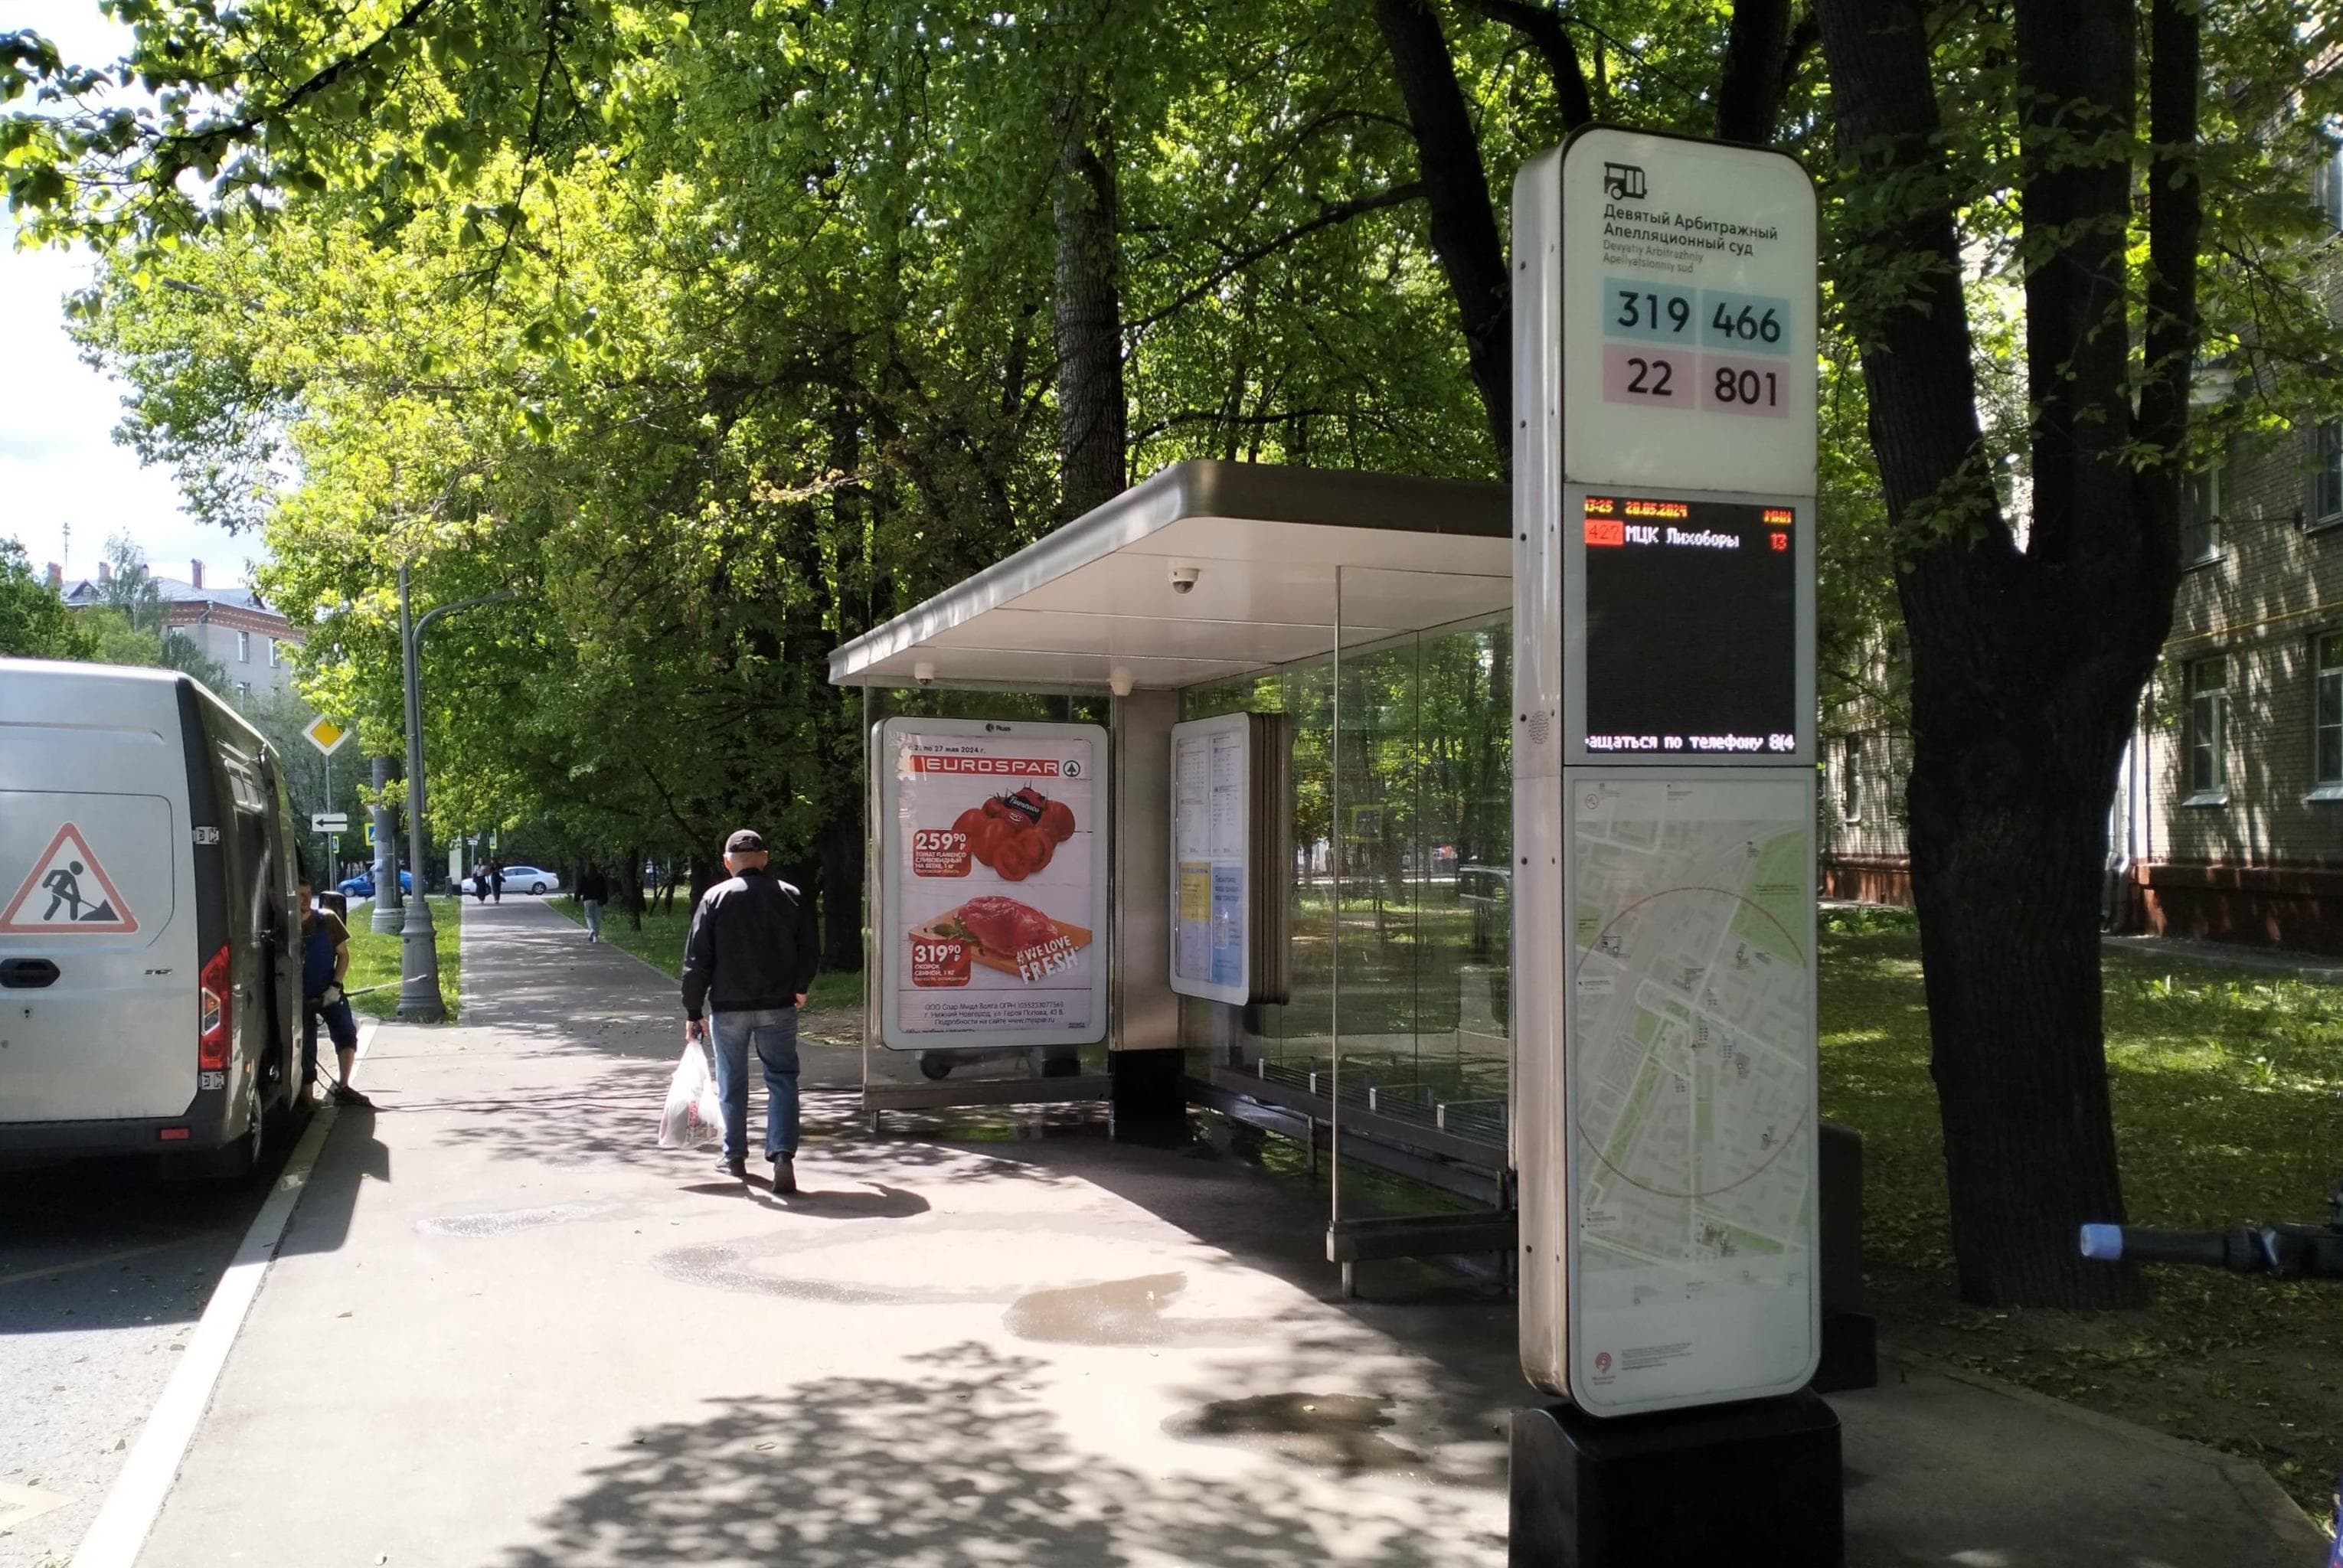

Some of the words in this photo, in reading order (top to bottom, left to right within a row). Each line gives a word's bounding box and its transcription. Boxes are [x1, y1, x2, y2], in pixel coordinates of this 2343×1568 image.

[1604, 204, 1670, 225] Девятый
[1675, 214, 1777, 240] Арбитражный
[1604, 222, 1725, 250] Апелляционный
[1729, 241, 1753, 256] суд
[1617, 289, 1690, 332] 319
[1712, 302, 1781, 344] 466
[1627, 358, 1673, 397] 22
[1714, 367, 1776, 407] 801
[1625, 524, 1660, 545] МЦК
[1666, 527, 1740, 549] Лихоборы
[1770, 533, 1788, 551] 13
[1585, 735, 1658, 750] ащаться
[1664, 736, 1683, 750] по
[1689, 733, 1763, 751] телефону
[926, 757, 1058, 774] EUROSPAR
[916, 832, 953, 851] 259
[914, 945, 948, 962] 319
[1044, 935, 1072, 954] LOVE
[1019, 947, 1079, 985] FRESH
